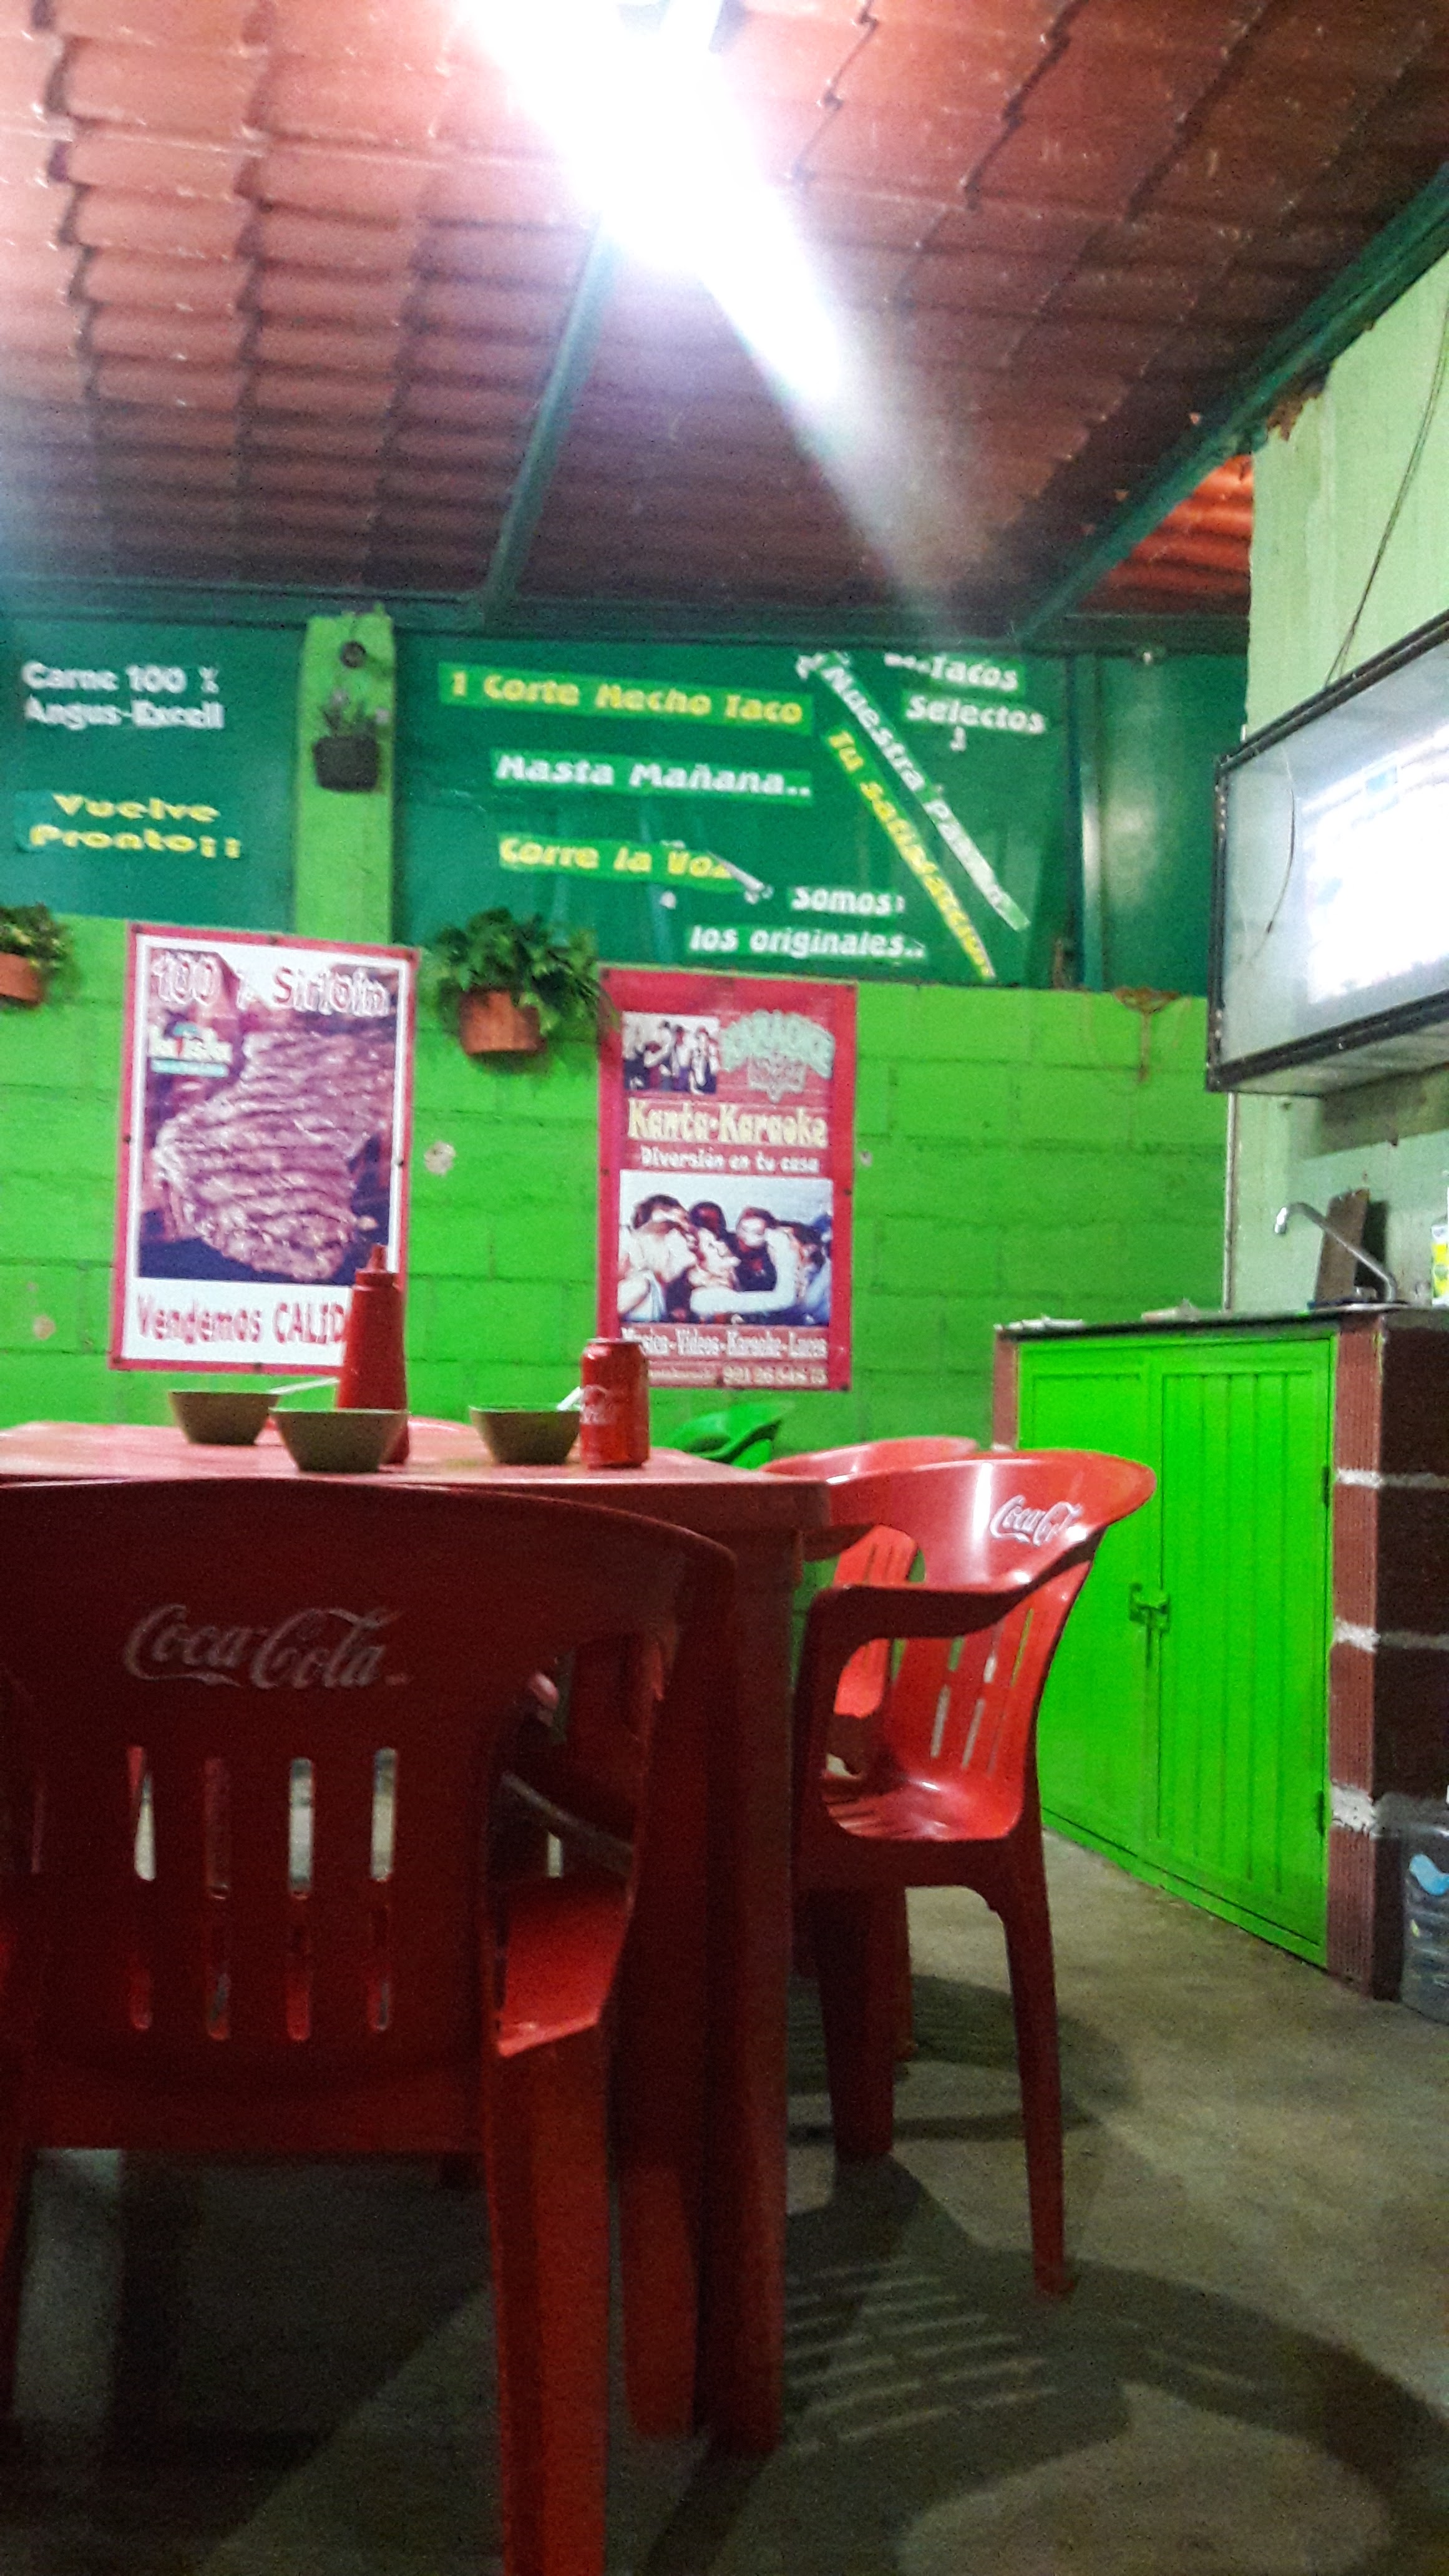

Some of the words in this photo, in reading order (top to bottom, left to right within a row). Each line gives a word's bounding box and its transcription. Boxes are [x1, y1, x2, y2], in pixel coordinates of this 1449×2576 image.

[21, 660, 119, 691] Carne
[126, 665, 187, 694] 100
[483, 674, 580, 706] Corte
[594, 683, 712, 715] Hecho
[724, 693, 803, 723] Taco
[905, 695, 1046, 734] Selectos
[821, 665, 926, 792] Nuestra
[495, 754, 615, 786] Hasta
[827, 729, 866, 772] Tu
[52, 793, 221, 824] Vuelve
[500, 837, 600, 869] Corre
[613, 847, 652, 872] la
[689, 925, 740, 952] los
[149, 952, 217, 1007] 100
[273, 967, 392, 1017] Sirloin
[728, 1154, 751, 1170] en
[779, 1156, 821, 1174] casa
[136, 1293, 263, 1345] Vendemos
[990, 1494, 1084, 1548] Coca-Col
[124, 1603, 399, 1690] Coca-Cola
